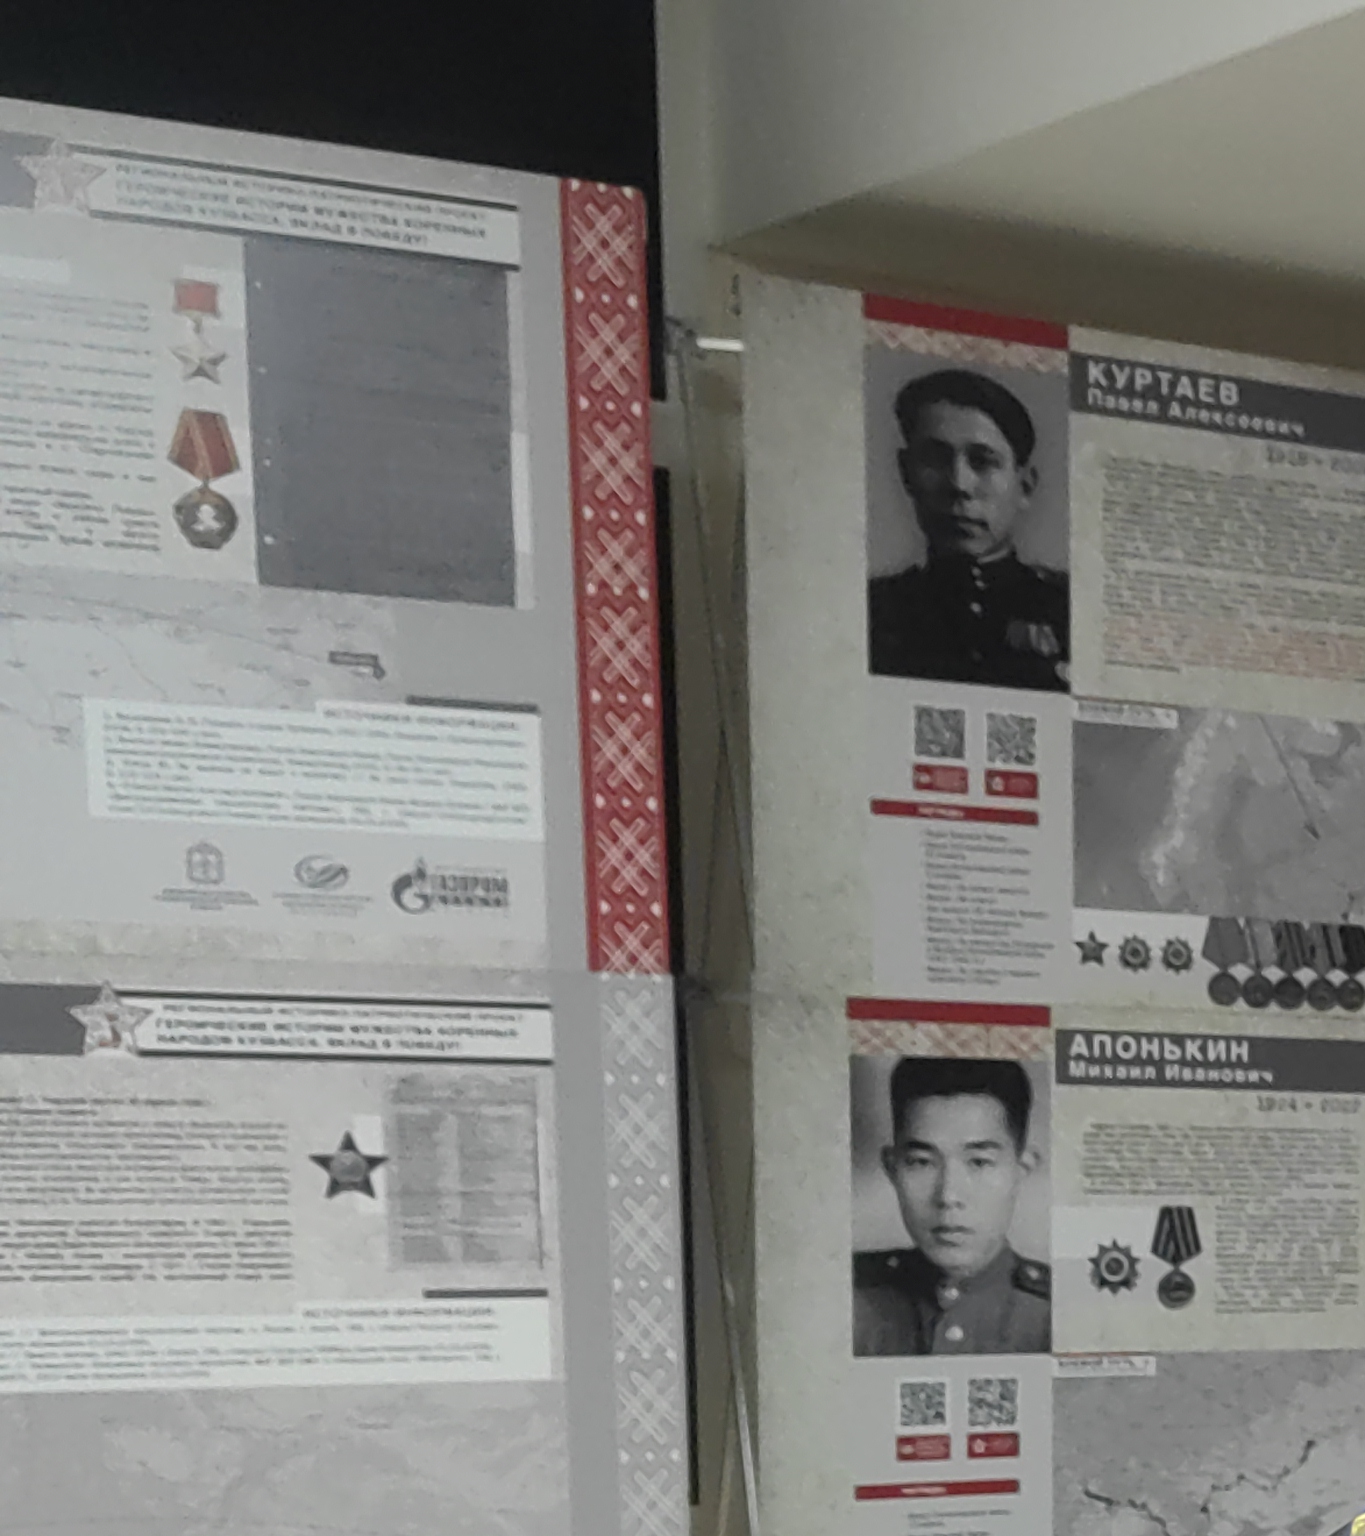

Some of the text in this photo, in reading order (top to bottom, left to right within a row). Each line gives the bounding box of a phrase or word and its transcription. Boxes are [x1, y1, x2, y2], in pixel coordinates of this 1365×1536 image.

[1087, 359, 1241, 407] КУРТАЕВ
[1087, 388, 1306, 439] Павел Алексеевич
[1069, 1033, 1250, 1064] АПОНЬКИН
[1068, 1060, 1274, 1085] Михаил Иванович
